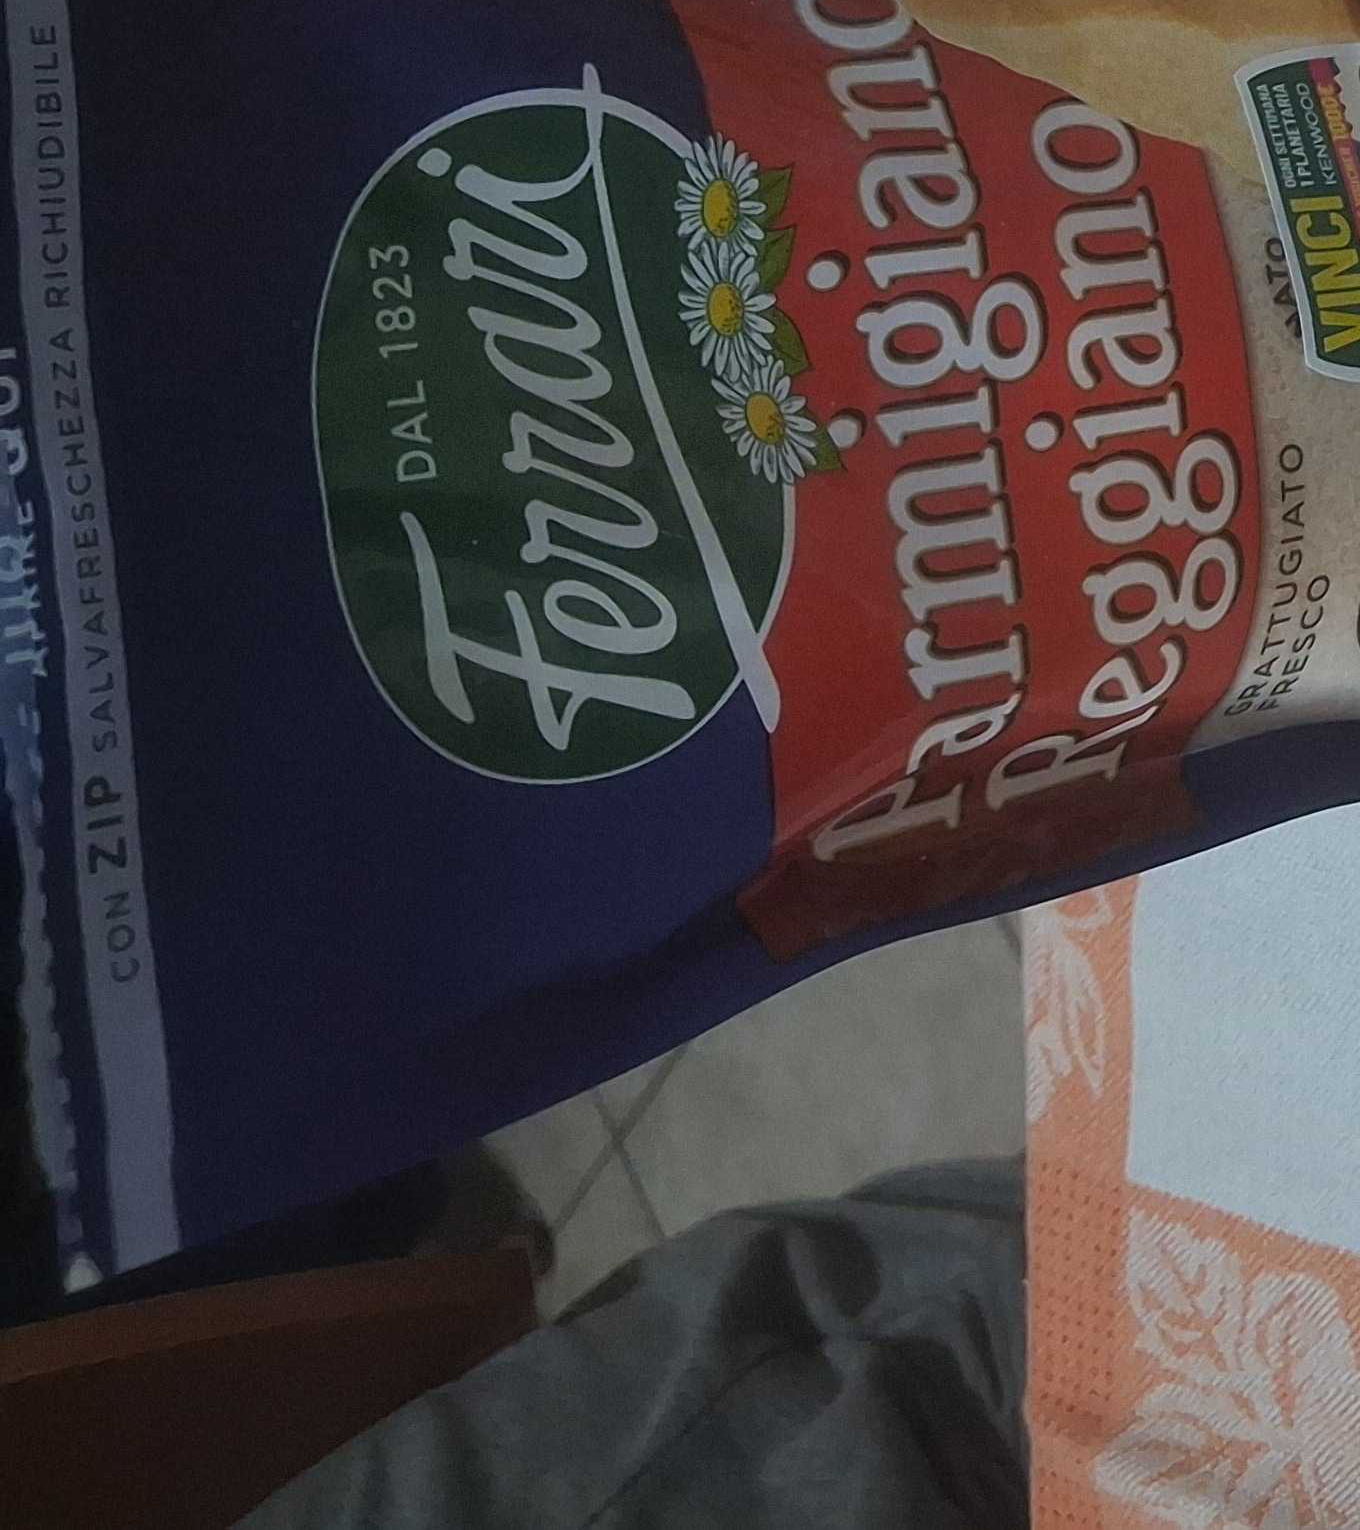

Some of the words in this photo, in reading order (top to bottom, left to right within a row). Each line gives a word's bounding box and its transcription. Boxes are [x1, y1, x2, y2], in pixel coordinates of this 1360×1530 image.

[29, 23, 71, 309] RICHIUDIBILE
[1255, 82, 1288, 155] SETTIMANA
[1272, 82, 1312, 176] PLANETARIA
[1278, 156, 1297, 187] OGNI
[1295, 81, 1337, 184] KENWOOD
[367, 242, 420, 358] 1823
[389, 378, 438, 482] DAL
[399, 139, 697, 750] Ferrari
[1023, 96, 1242, 809] Reggiano
[48, 326, 119, 753] SALVAFRESCHEZZA
[1223, 441, 1305, 716] GRATTUGIATO
[1256, 573, 1331, 710] FRESCO
[82, 774, 129, 873] ZIP
[102, 889, 141, 982] CON
